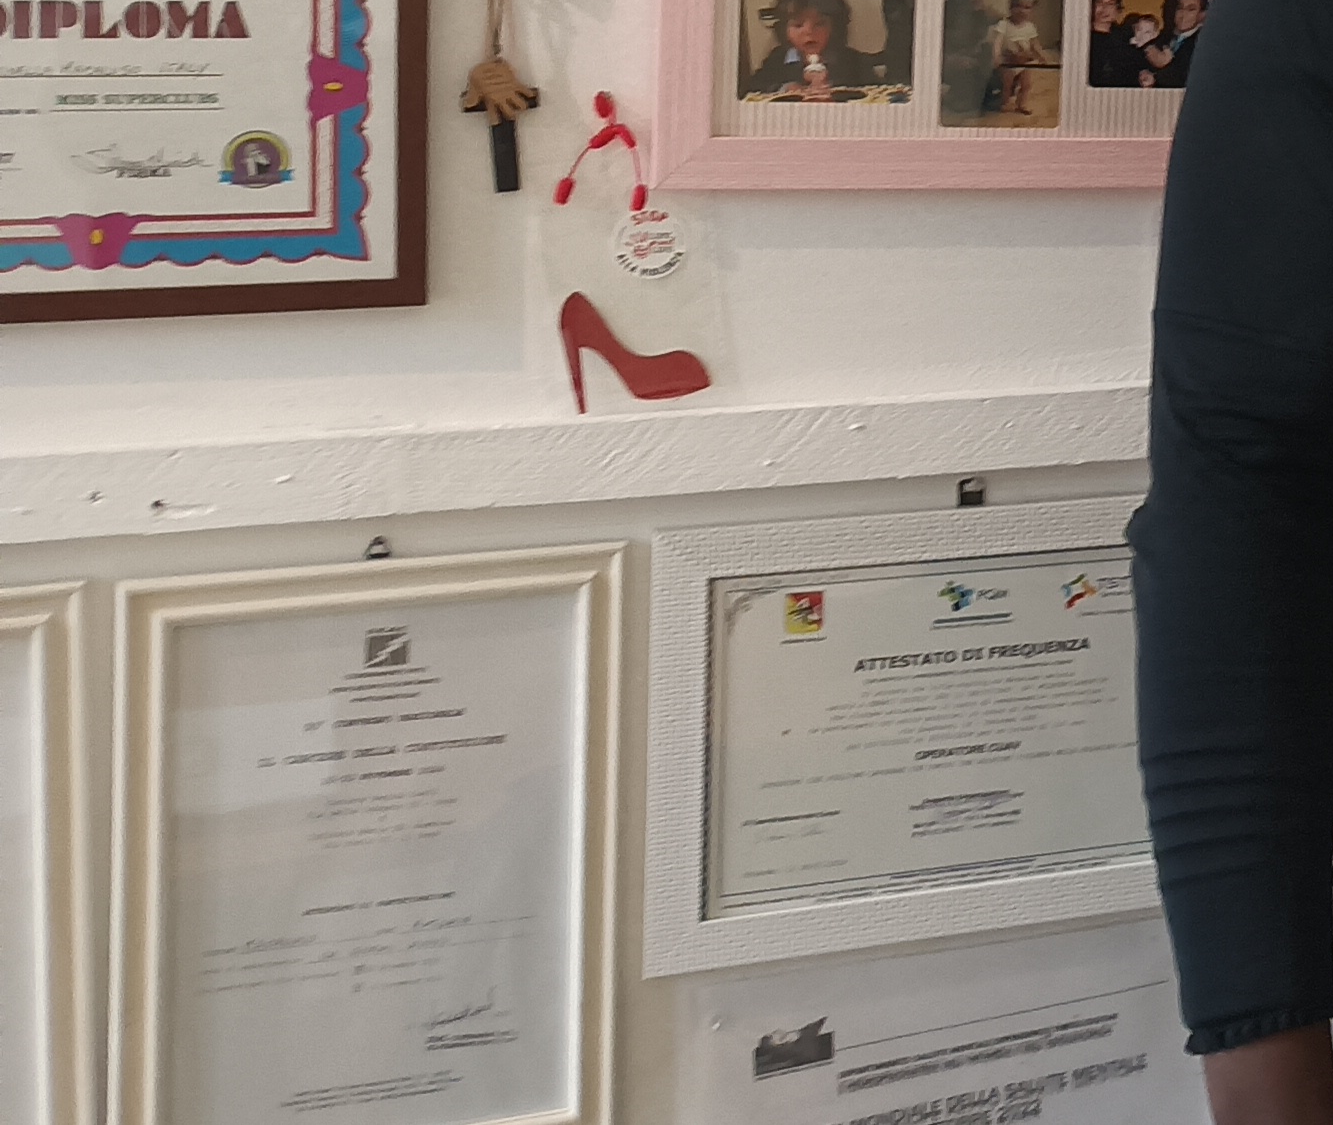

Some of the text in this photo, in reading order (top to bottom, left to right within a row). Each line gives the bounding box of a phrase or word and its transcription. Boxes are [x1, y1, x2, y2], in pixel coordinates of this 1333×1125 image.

[854, 637, 1090, 673] ATTESTATO DI FREQUENZA
